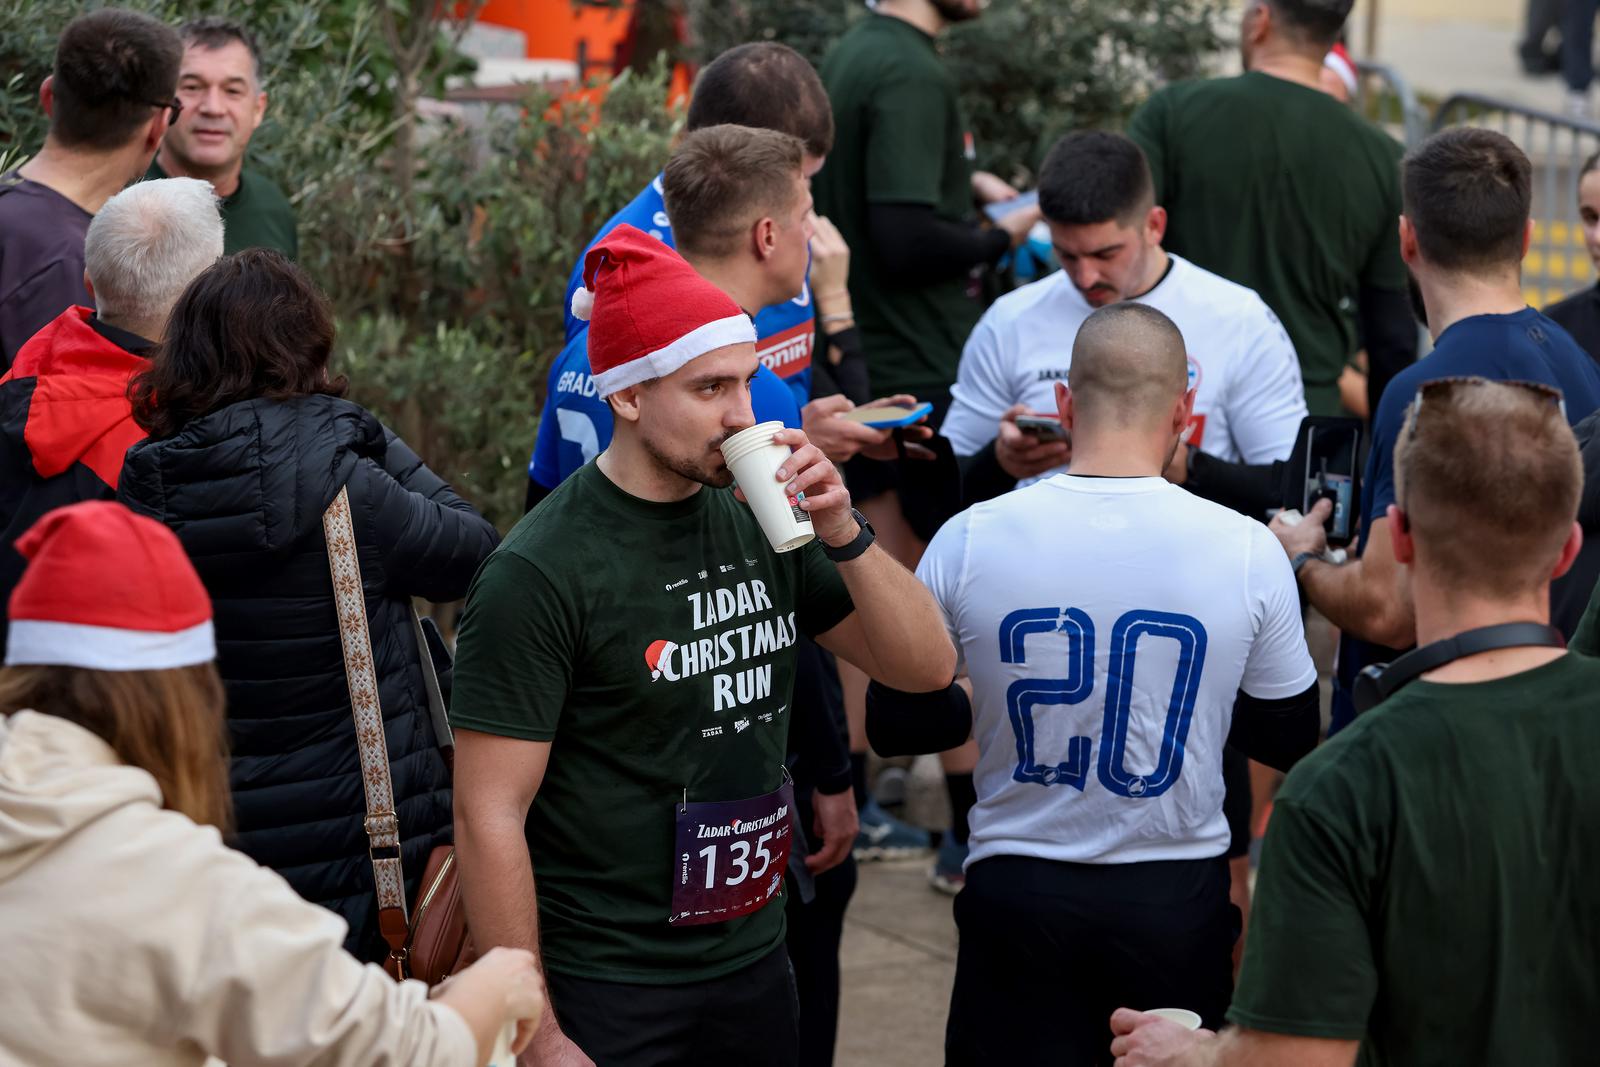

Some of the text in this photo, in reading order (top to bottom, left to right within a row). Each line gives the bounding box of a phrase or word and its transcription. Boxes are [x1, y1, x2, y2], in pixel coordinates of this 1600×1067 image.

[687, 579, 773, 631] ZADAR
[662, 611, 797, 682] CHRISTMAS
[713, 663, 772, 712] RUN
[998, 607, 1208, 798] 20
[697, 824, 731, 839] ZADAR
[732, 812, 776, 835] CHRISTMAS
[776, 805, 788, 822] RUN
[699, 832, 773, 889] 135
